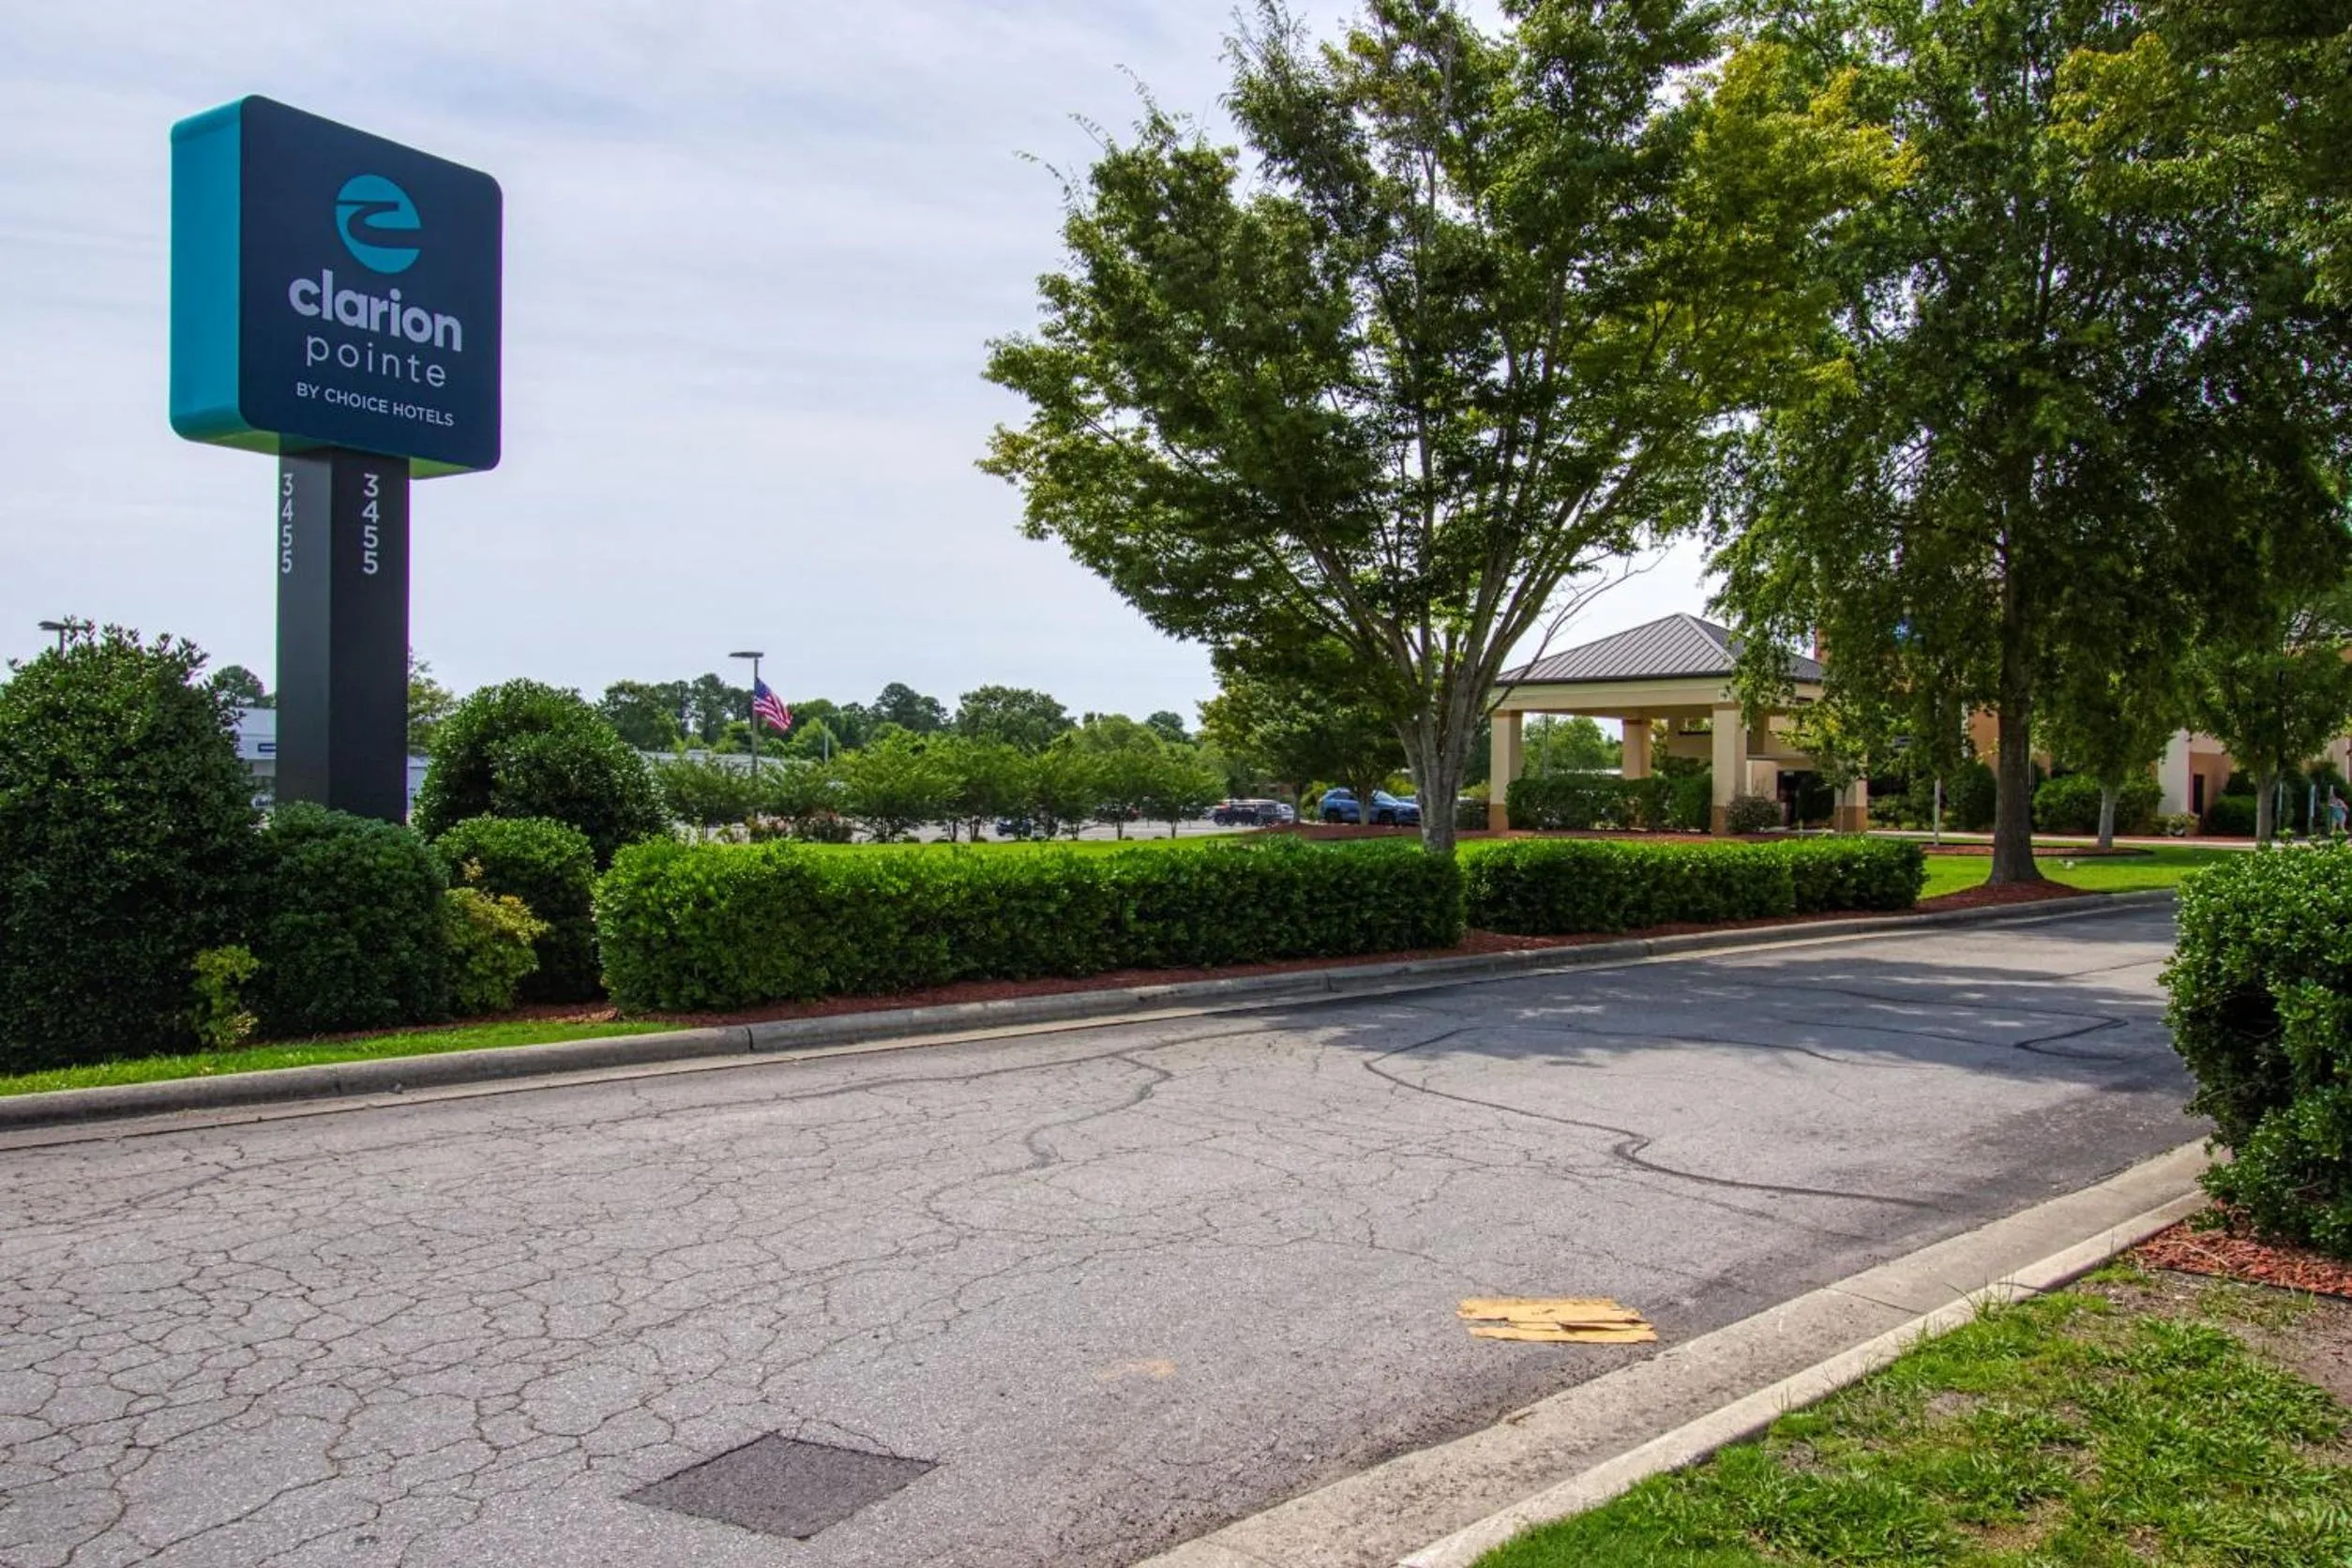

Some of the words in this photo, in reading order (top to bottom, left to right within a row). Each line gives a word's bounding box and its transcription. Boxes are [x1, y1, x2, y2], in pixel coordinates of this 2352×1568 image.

[289, 268, 462, 352] clarion
[307, 336, 446, 387] pointe
[296, 382, 320, 399] BY
[324, 388, 388, 414] CHOICE
[393, 402, 455, 427] HOTELS
[281, 473, 294, 574] 3455
[362, 473, 380, 575] 3455
